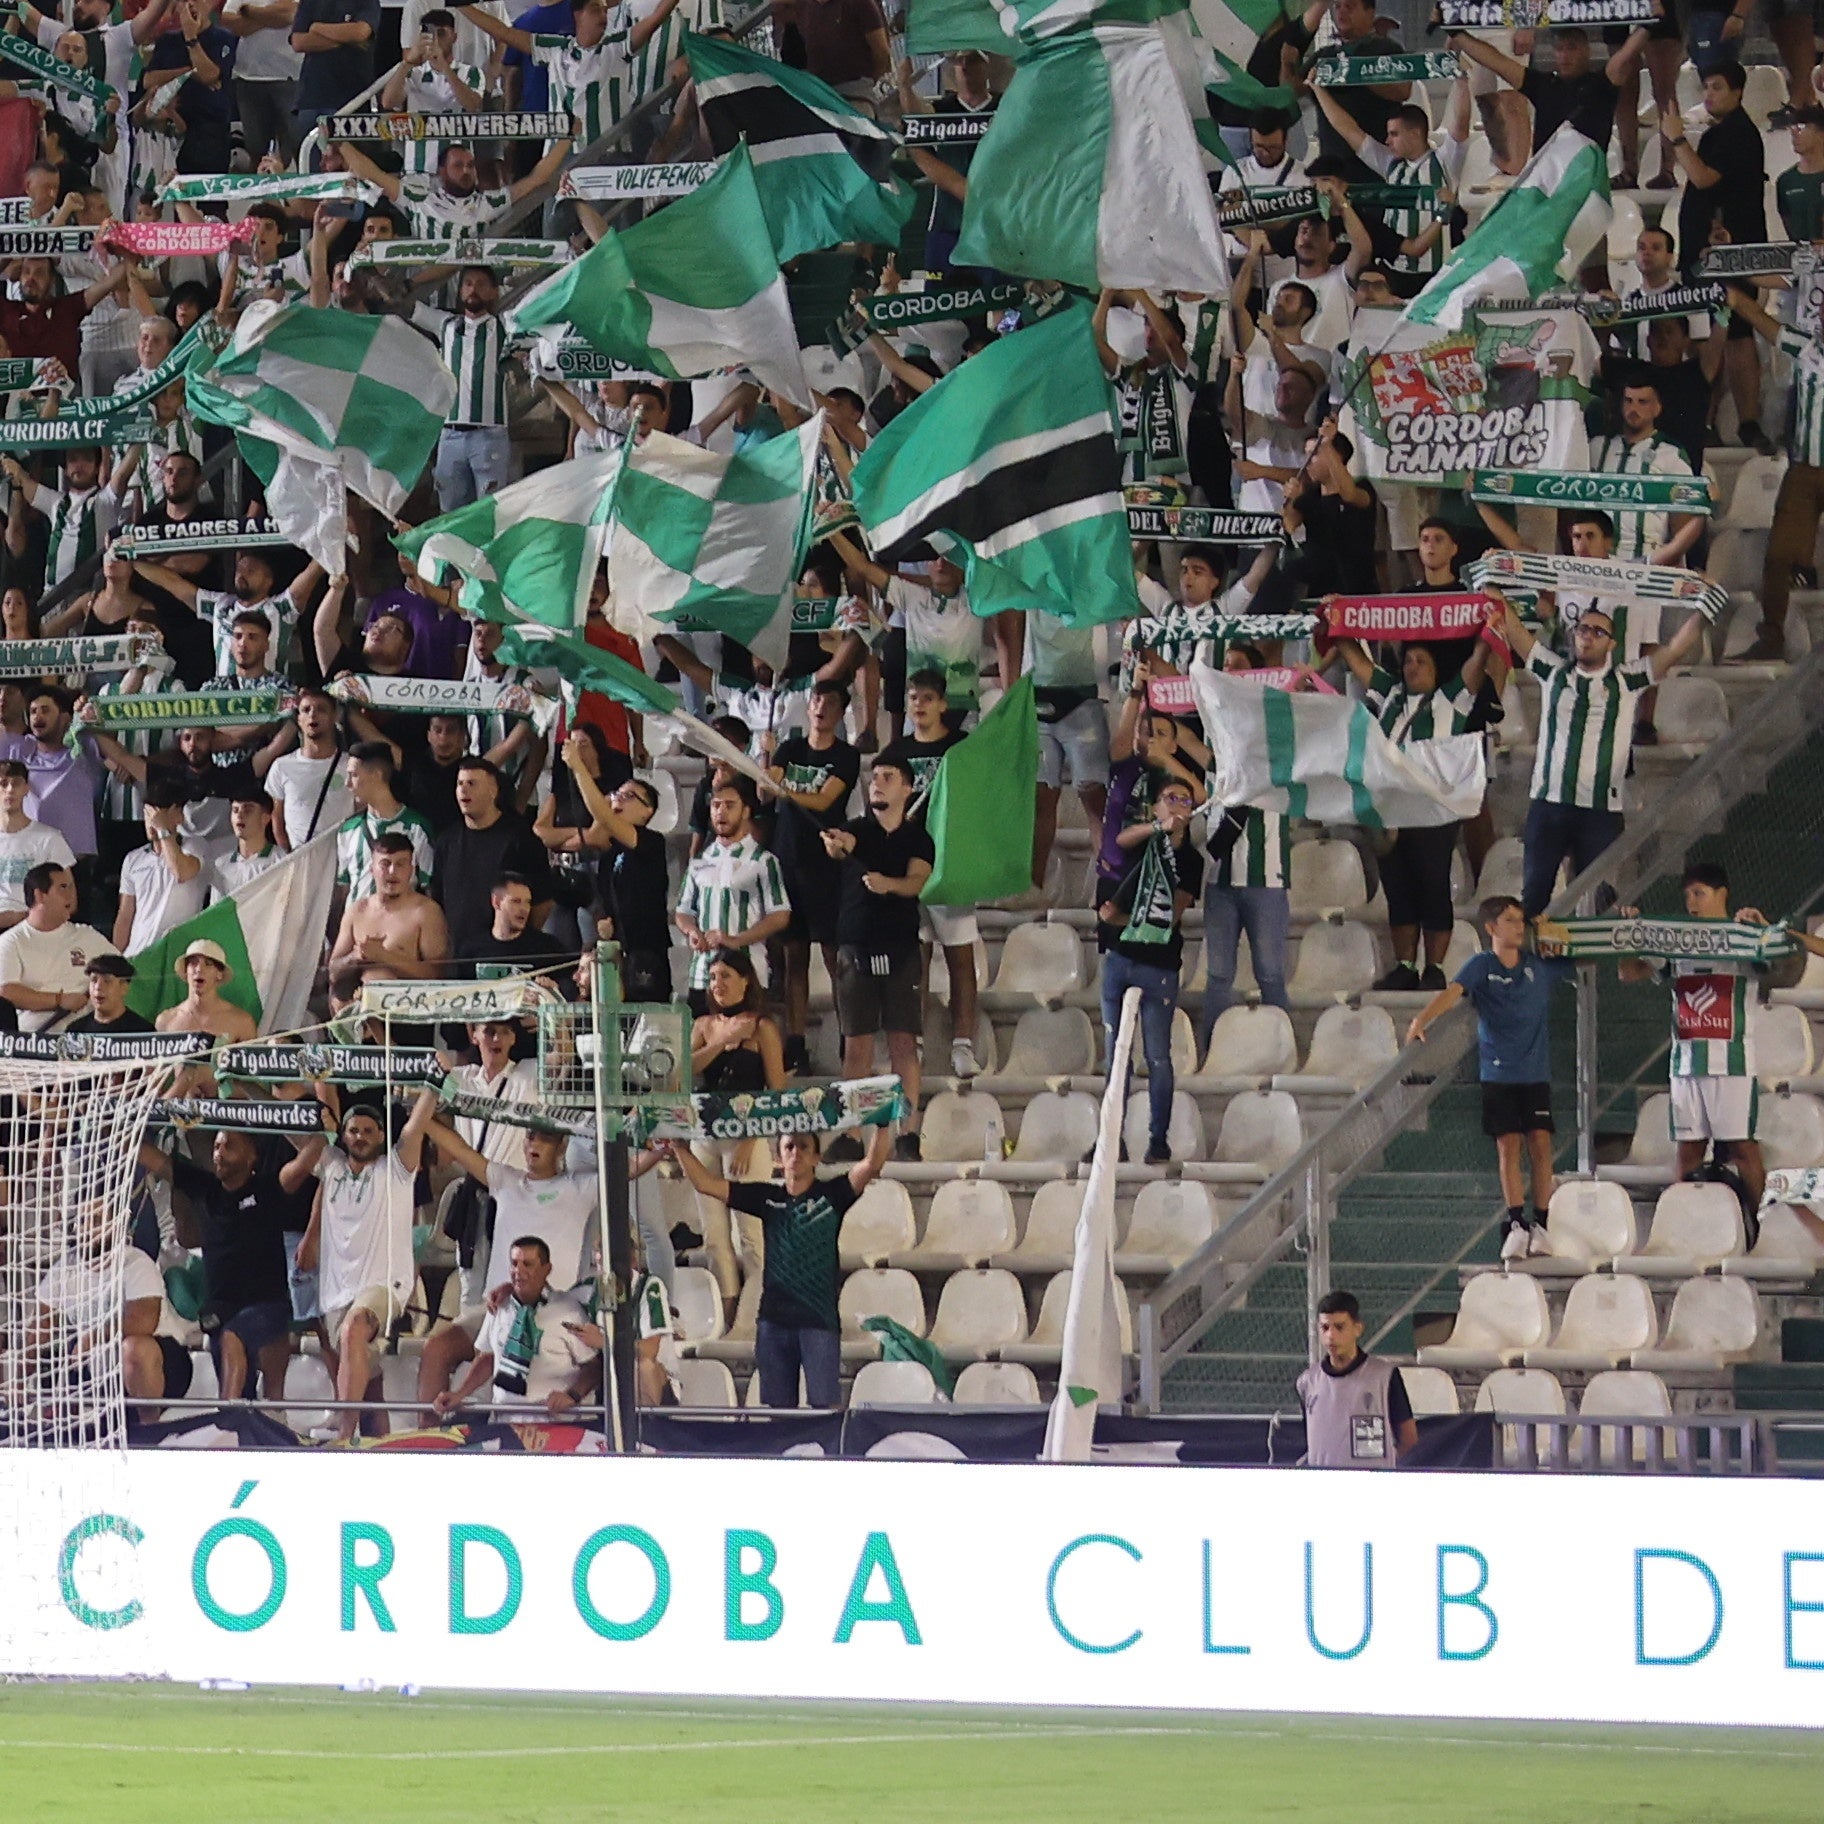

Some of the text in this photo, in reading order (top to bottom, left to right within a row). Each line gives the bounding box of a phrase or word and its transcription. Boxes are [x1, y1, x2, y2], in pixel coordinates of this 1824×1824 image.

[333, 113, 570, 138] XXX ANIVERSARIO
[905, 114, 990, 140] Brigadas
[616, 162, 711, 189] VOLVEREMOS
[1387, 406, 1546, 445] CÓRDOBA
[1386, 436, 1549, 473] FANATICS
[1534, 477, 1645, 501] CÓRDOBA
[133, 516, 261, 541] DE PADRES A
[1128, 510, 1283, 535] DEL DIECIOC
[1344, 603, 1437, 629] CÓRDOBA
[384, 679, 481, 702] CÓRDOBA
[57, 1476, 923, 1647] CÓRDOBA
[1046, 1530, 1499, 1664] CLUB
